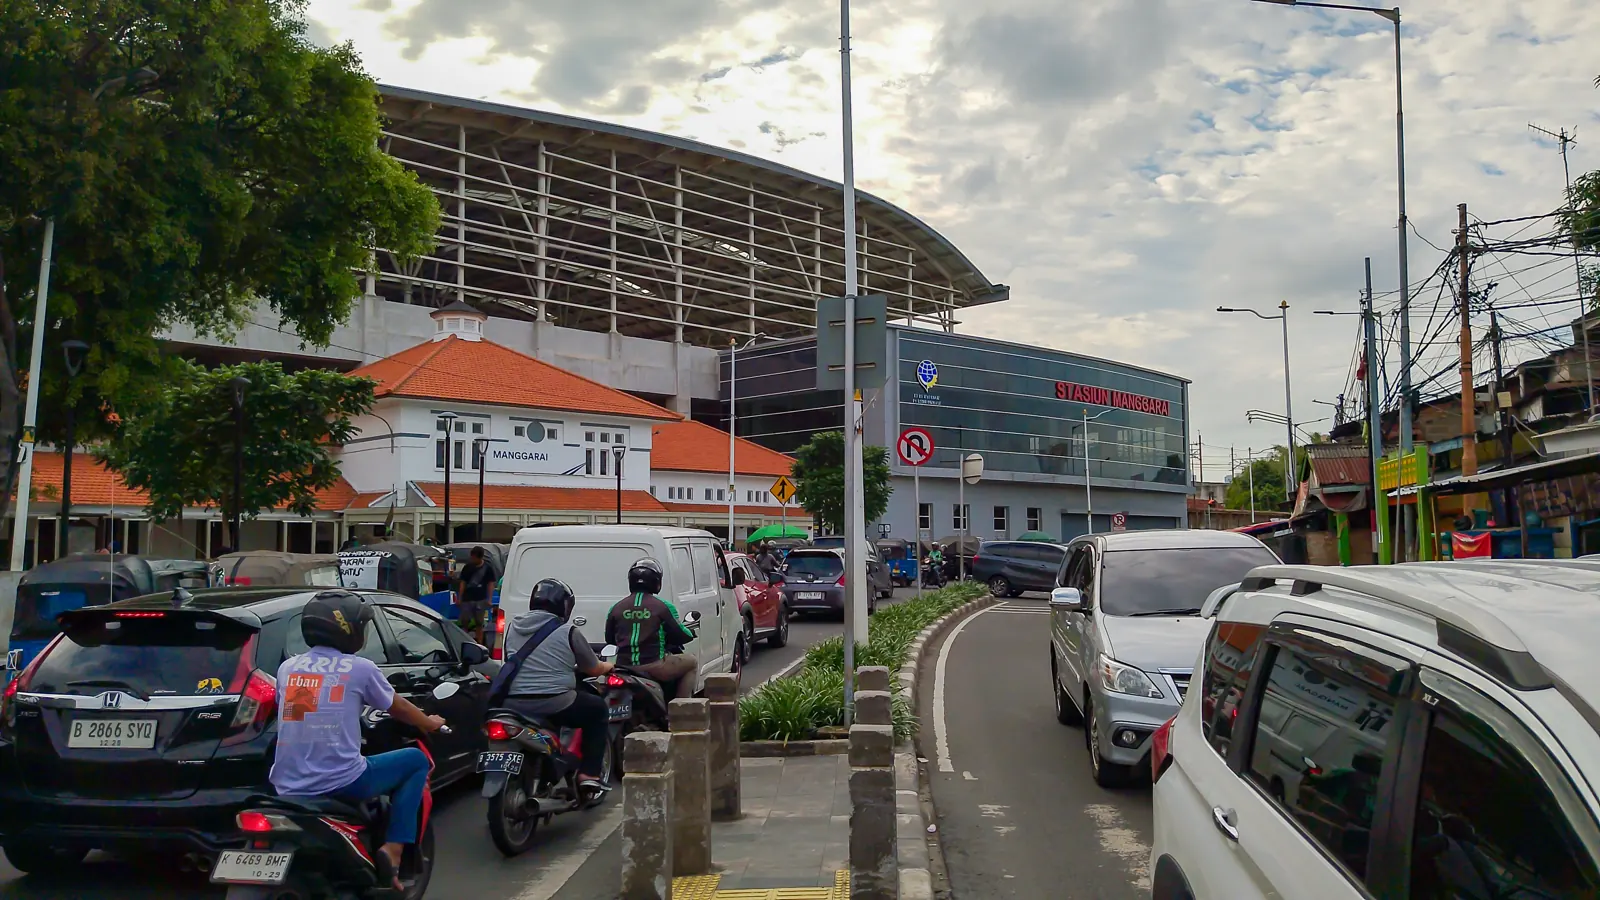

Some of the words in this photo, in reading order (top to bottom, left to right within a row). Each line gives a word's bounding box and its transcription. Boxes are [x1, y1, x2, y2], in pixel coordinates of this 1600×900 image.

[1055, 381, 1109, 405] STASIUN
[1111, 390, 1170, 417] MANGGARAI
[493, 450, 549, 461] MANGGARAI
[340, 557, 365, 566] AKAN
[340, 567, 364, 577] RATIS
[623, 608, 652, 619] Grab
[1422, 692, 1440, 706] XL7
[73, 723, 83, 738] B
[89, 722, 122, 738] 2866
[127, 723, 153, 739] SYQ
[486, 753, 504, 762] 3575
[506, 753, 522, 764] SXE
[222, 853, 231, 865] K
[235, 854, 263, 866] 6469
[265, 855, 288, 867] BMF
